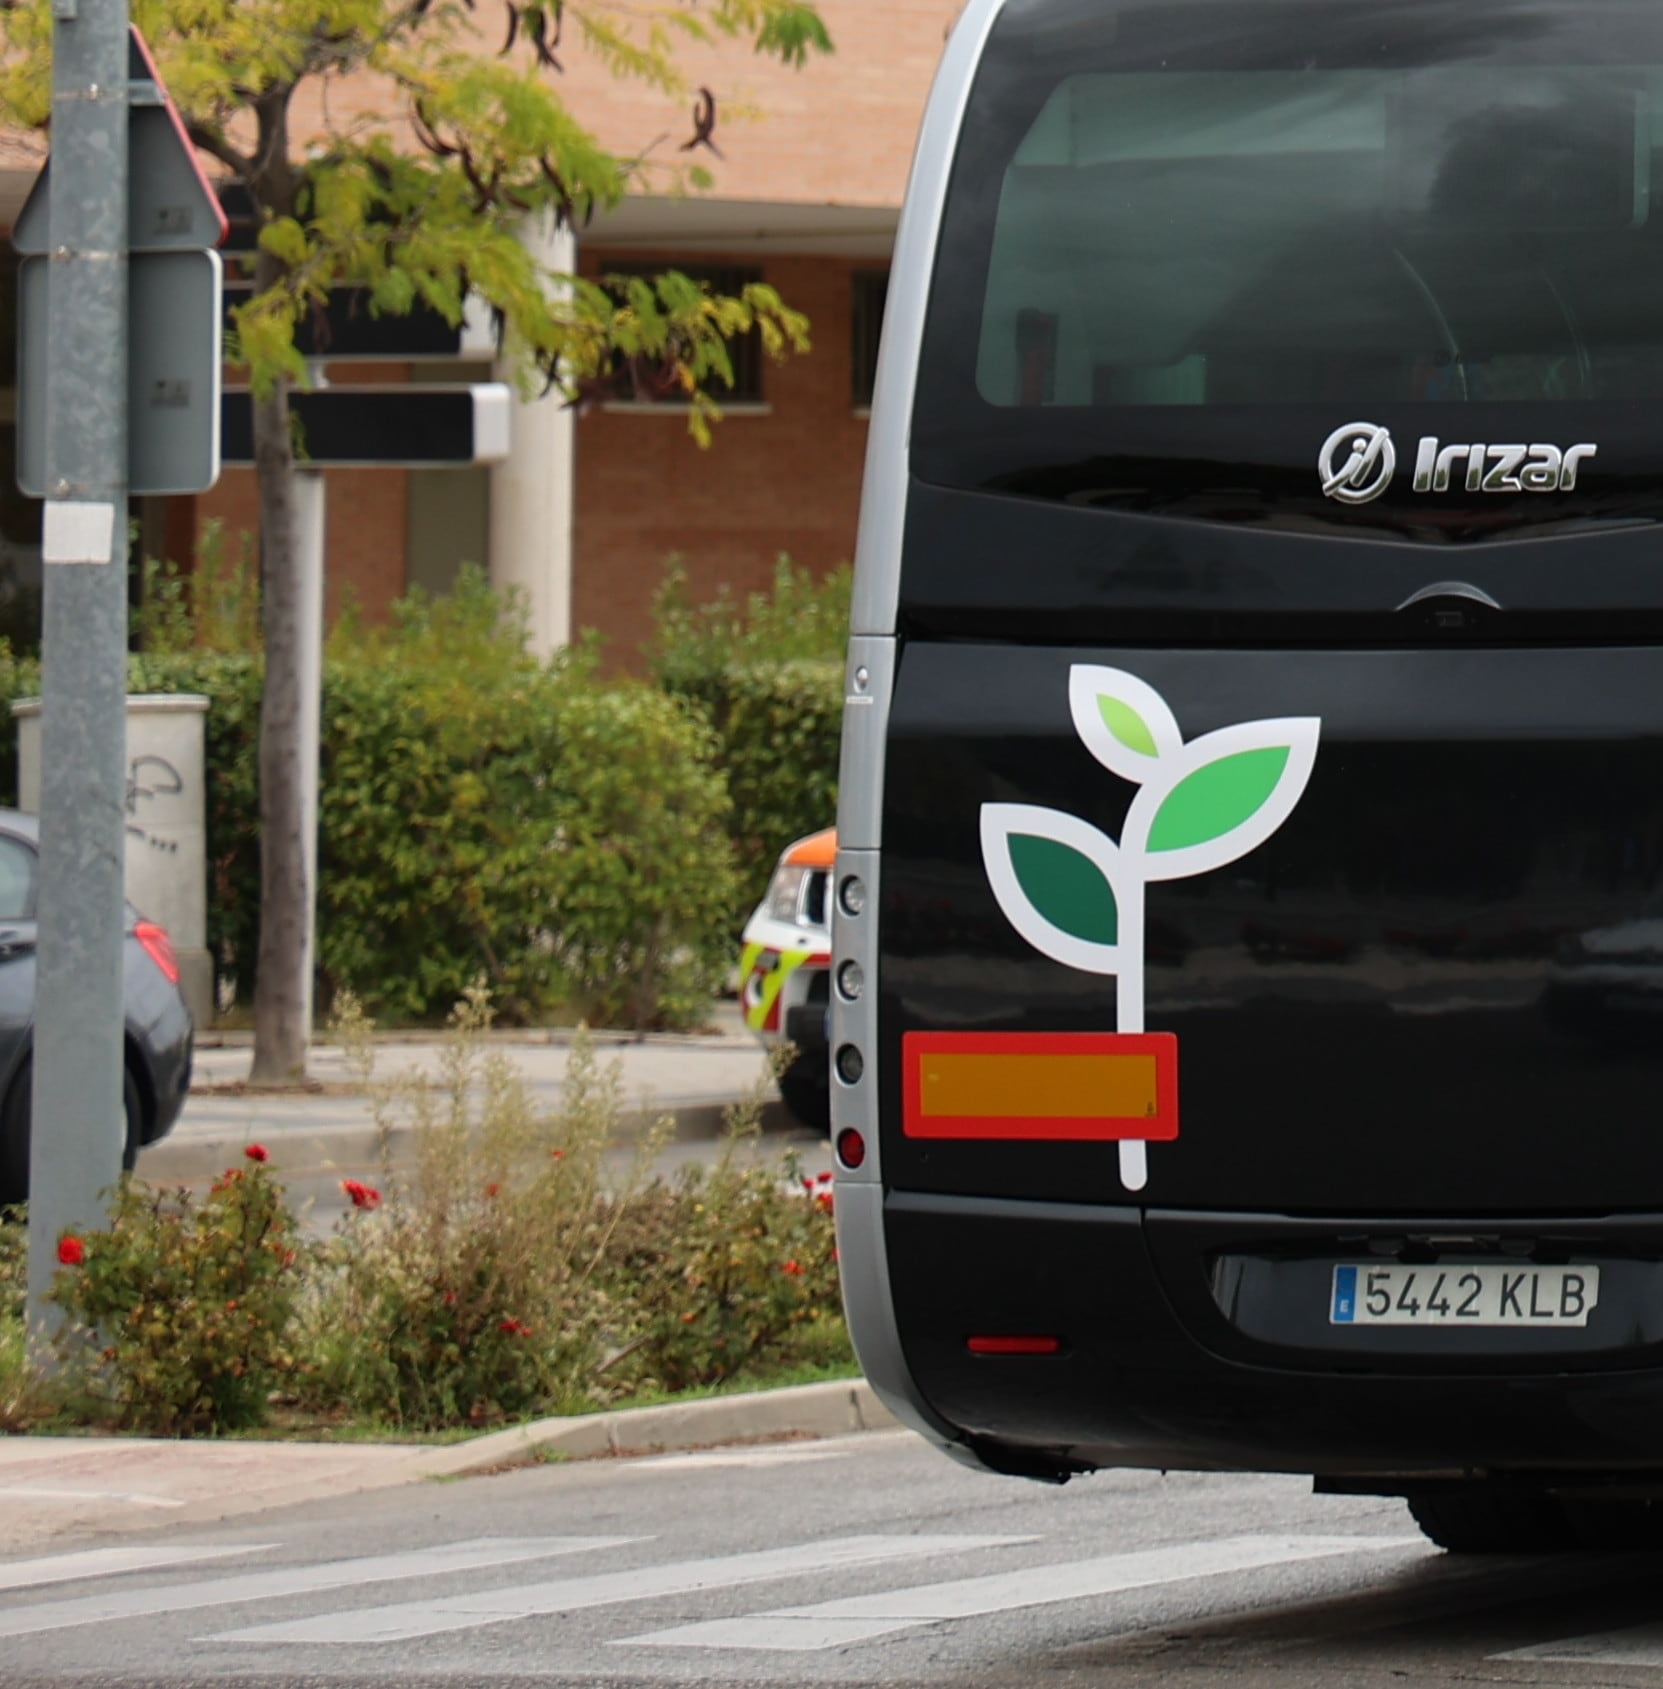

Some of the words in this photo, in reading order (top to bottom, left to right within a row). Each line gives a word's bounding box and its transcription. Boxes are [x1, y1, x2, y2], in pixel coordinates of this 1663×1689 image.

[1413, 437, 1597, 492] Irizar
[1366, 1272, 1482, 1316] 5442
[1500, 1273, 1585, 1317] KLB
